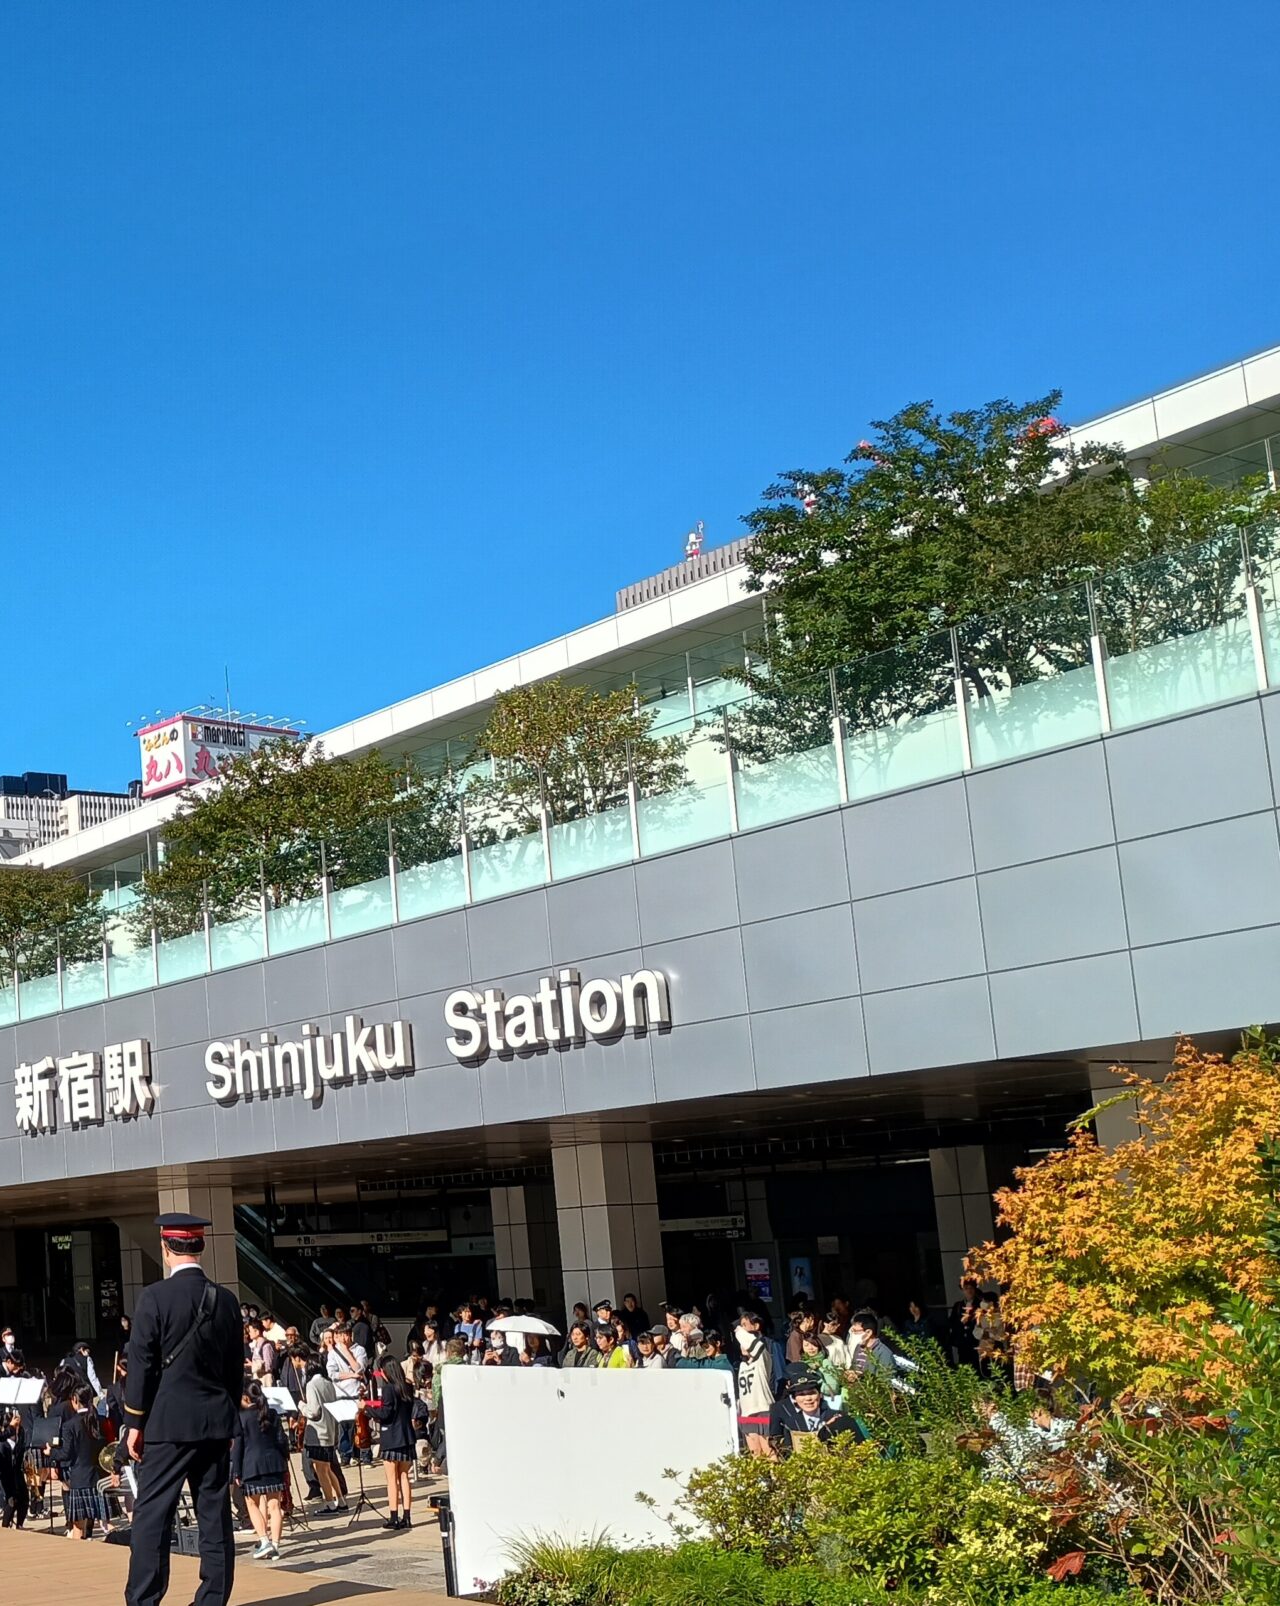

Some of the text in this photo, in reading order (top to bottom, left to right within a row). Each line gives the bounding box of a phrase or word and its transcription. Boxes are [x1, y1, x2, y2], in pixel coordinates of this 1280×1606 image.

[144, 752, 183, 786] 丸八
[14, 1038, 154, 1132] 新宿駅
[204, 1014, 415, 1101] Shinjuku
[443, 968, 672, 1059] Station
